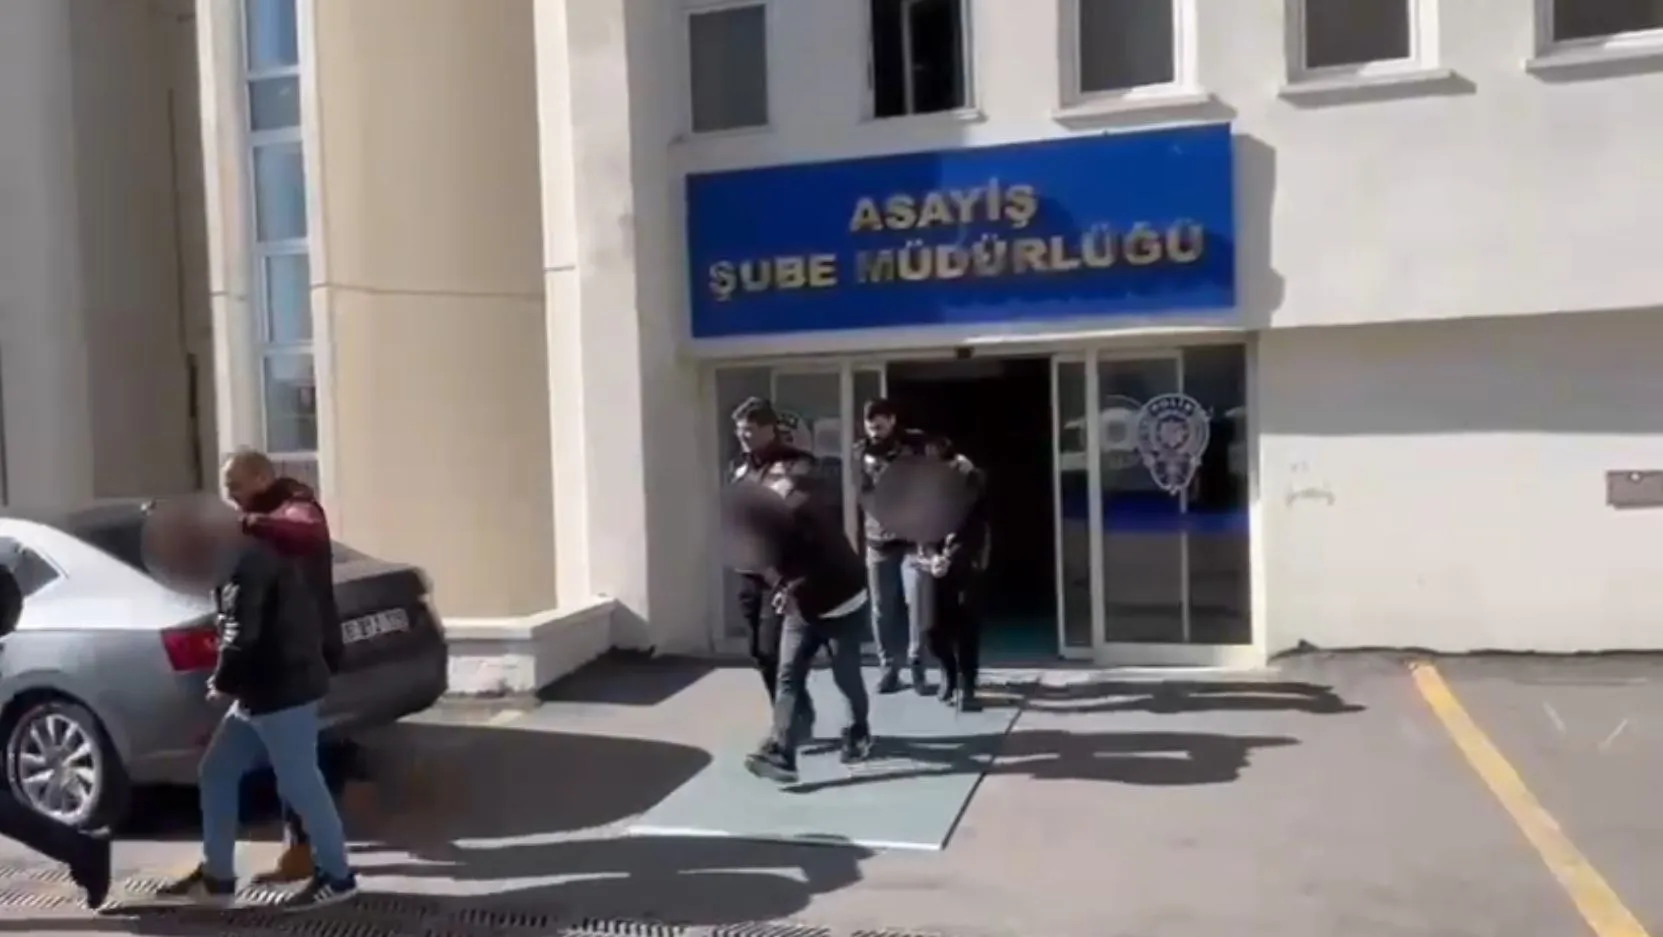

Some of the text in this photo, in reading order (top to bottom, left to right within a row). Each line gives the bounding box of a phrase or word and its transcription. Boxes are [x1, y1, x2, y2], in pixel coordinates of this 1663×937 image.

[850, 178, 1037, 232] ASAYİŞ
[709, 220, 1204, 300] ŞUBE MÜDÜRLÜĞÜ
